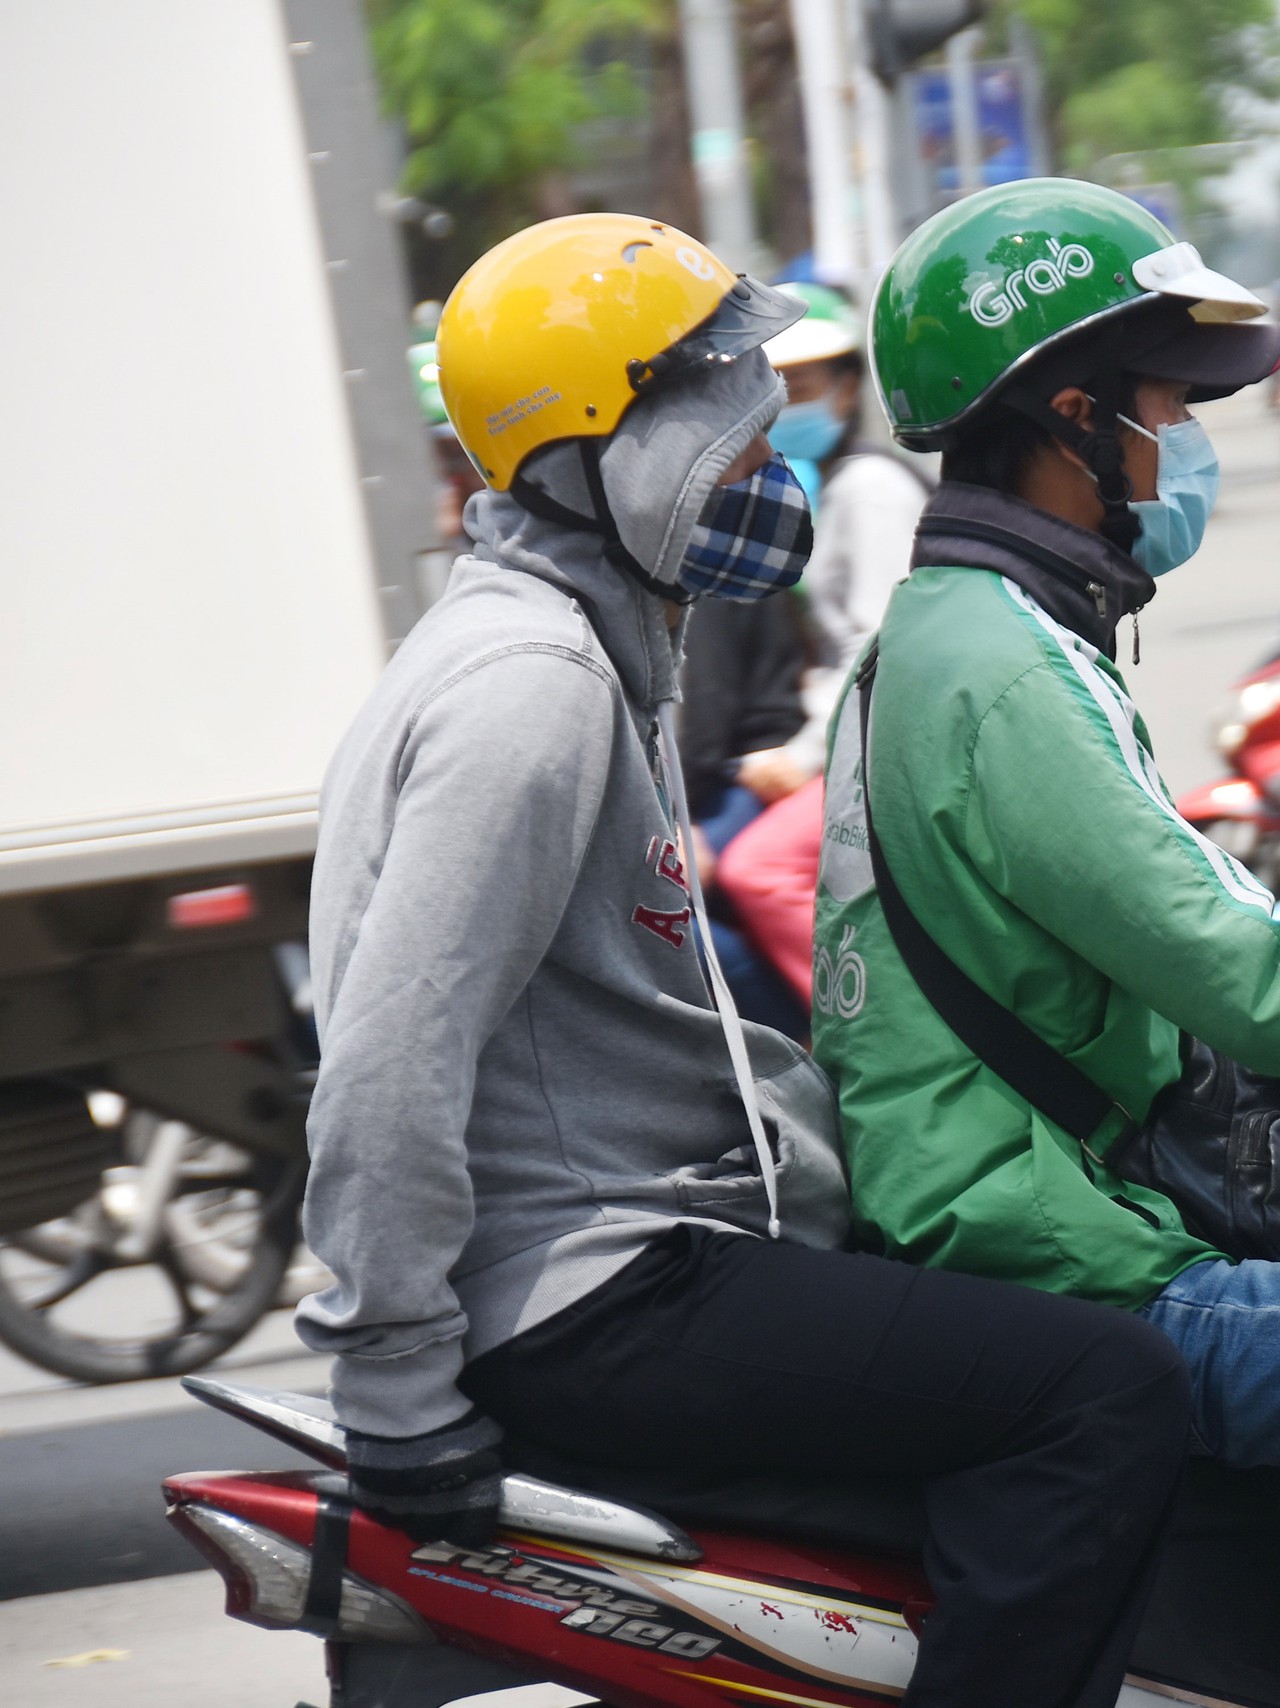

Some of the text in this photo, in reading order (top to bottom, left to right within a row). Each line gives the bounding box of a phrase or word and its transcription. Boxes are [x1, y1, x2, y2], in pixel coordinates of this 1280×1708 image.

[969, 237, 1095, 328] Grab
[533, 385, 552, 399] con
[406, 1566, 564, 1613] SPLENDID CRUISER
